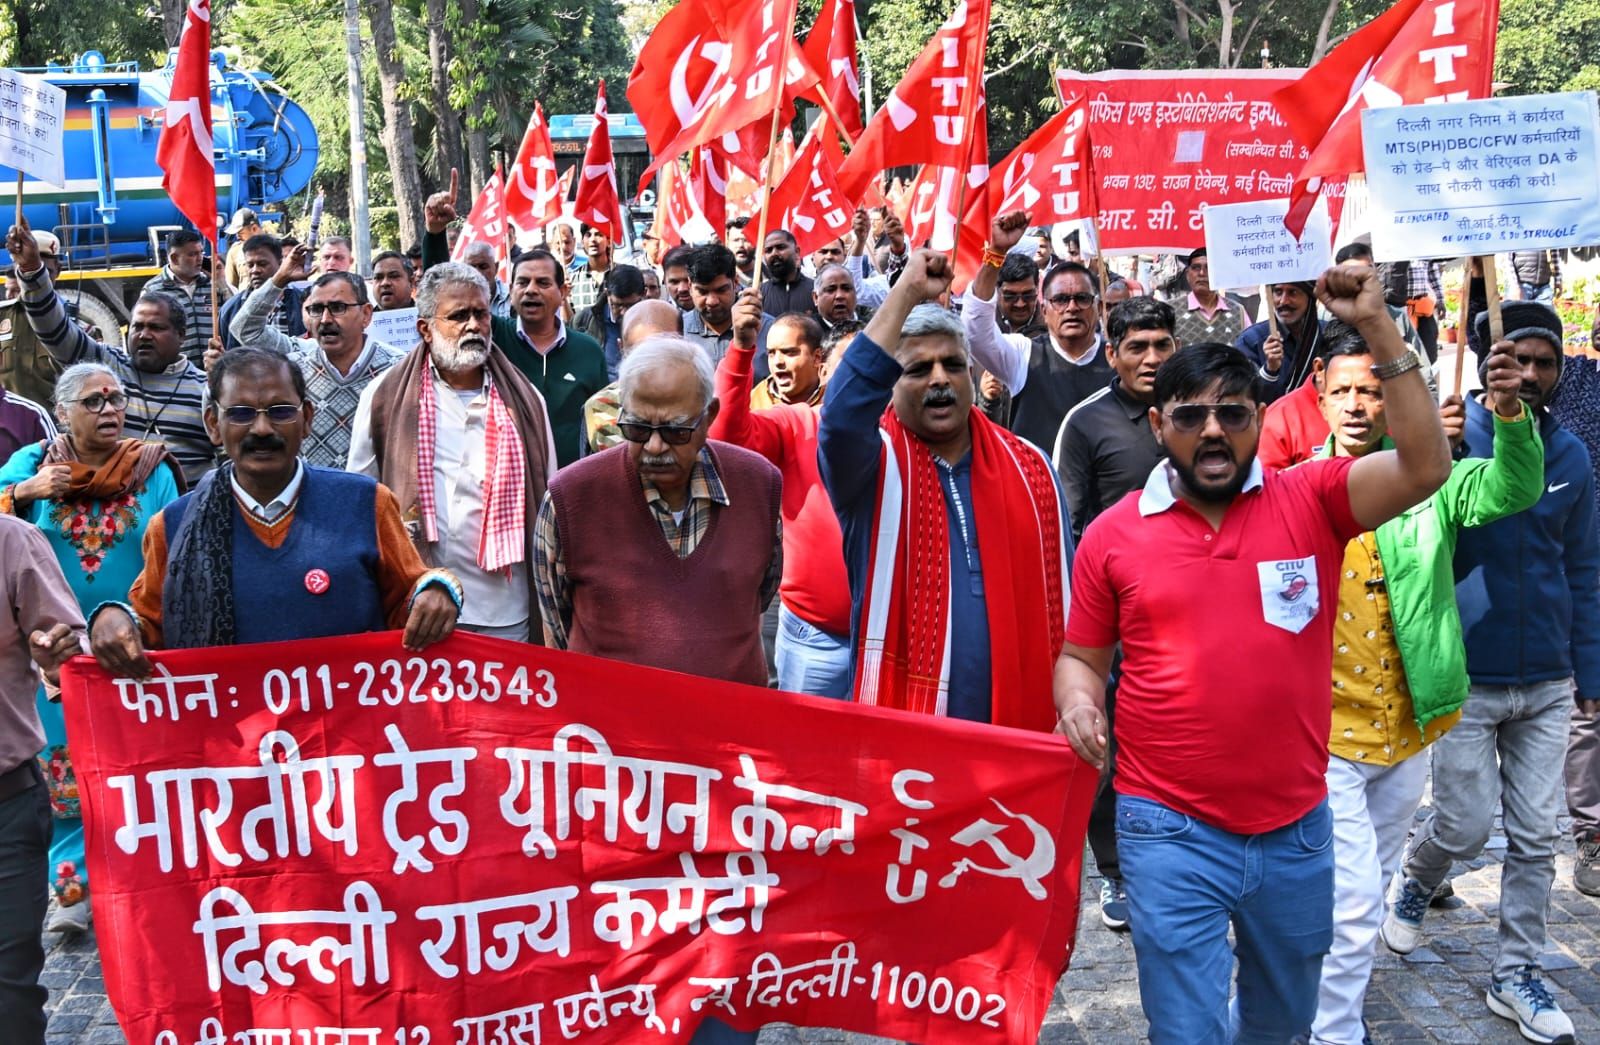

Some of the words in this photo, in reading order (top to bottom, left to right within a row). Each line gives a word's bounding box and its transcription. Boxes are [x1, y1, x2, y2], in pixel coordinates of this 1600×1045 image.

[1397, 116, 1431, 132] दिल्ली
[1437, 117, 1463, 130] नगर
[1469, 113, 1501, 128] निगम
[1508, 110, 1517, 125] में
[1523, 106, 1565, 123] कार्यरत
[1385, 133, 1518, 155] MTS(PH)DBC/CFW
[1521, 125, 1581, 144] कर्मचारियों
[1392, 160, 1407, 175] को
[1456, 155, 1479, 171] और
[1538, 152, 1561, 166] DA
[1564, 148, 1578, 164] के
[1103, 174, 1129, 190] भवन
[1235, 169, 1254, 194] नई
[1416, 181, 1441, 196] साथ
[1448, 176, 1483, 193] नौकरी
[1488, 173, 1521, 191] पक्की
[1527, 172, 1556, 188] करो!
[1147, 200, 1178, 230] सी.
[1236, 214, 1262, 228] दिल्ली
[1523, 224, 1579, 241] STRUGGLE
[1275, 560, 1304, 572] CITU
[264, 657, 559, 717] 011-23233543
[107, 729, 365, 874] भारतीय
[373, 723, 478, 875] ट्रेड
[494, 723, 723, 860] यूनियन
[885, 769, 935, 904] CTU
[193, 880, 397, 995] दिल्ली
[415, 885, 580, 979] राज्य
[592, 850, 780, 951] कमेटी
